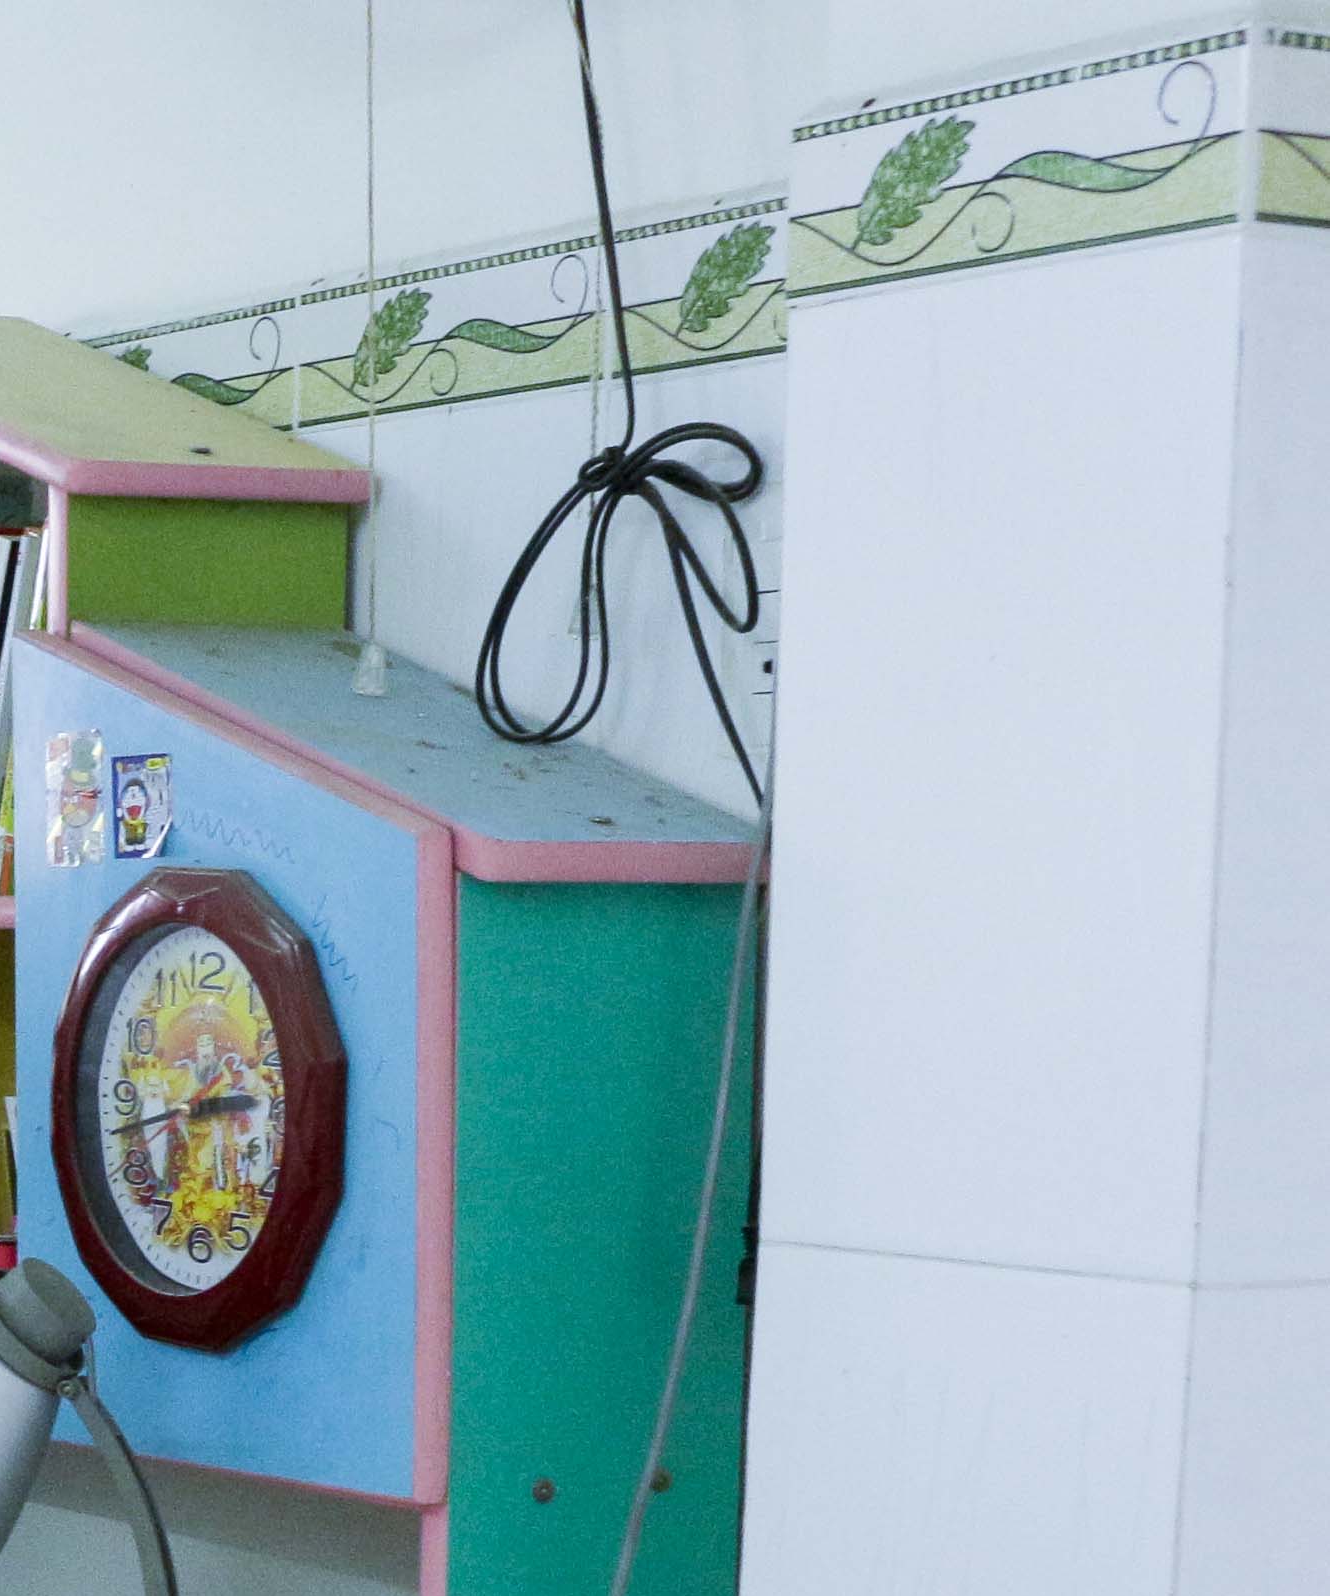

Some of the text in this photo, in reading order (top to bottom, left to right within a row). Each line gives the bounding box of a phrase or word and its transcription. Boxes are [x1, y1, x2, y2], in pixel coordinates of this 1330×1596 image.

[155, 967, 178, 1007] 11
[190, 951, 227, 991] 12
[246, 978, 255, 1015] 1
[127, 1017, 157, 1055] 10
[113, 1080, 137, 1116] 9
[123, 1148, 149, 1186] 8
[153, 1198, 173, 1236] 7
[227, 1212, 252, 1251] 5
[188, 1226, 214, 1264] 6
